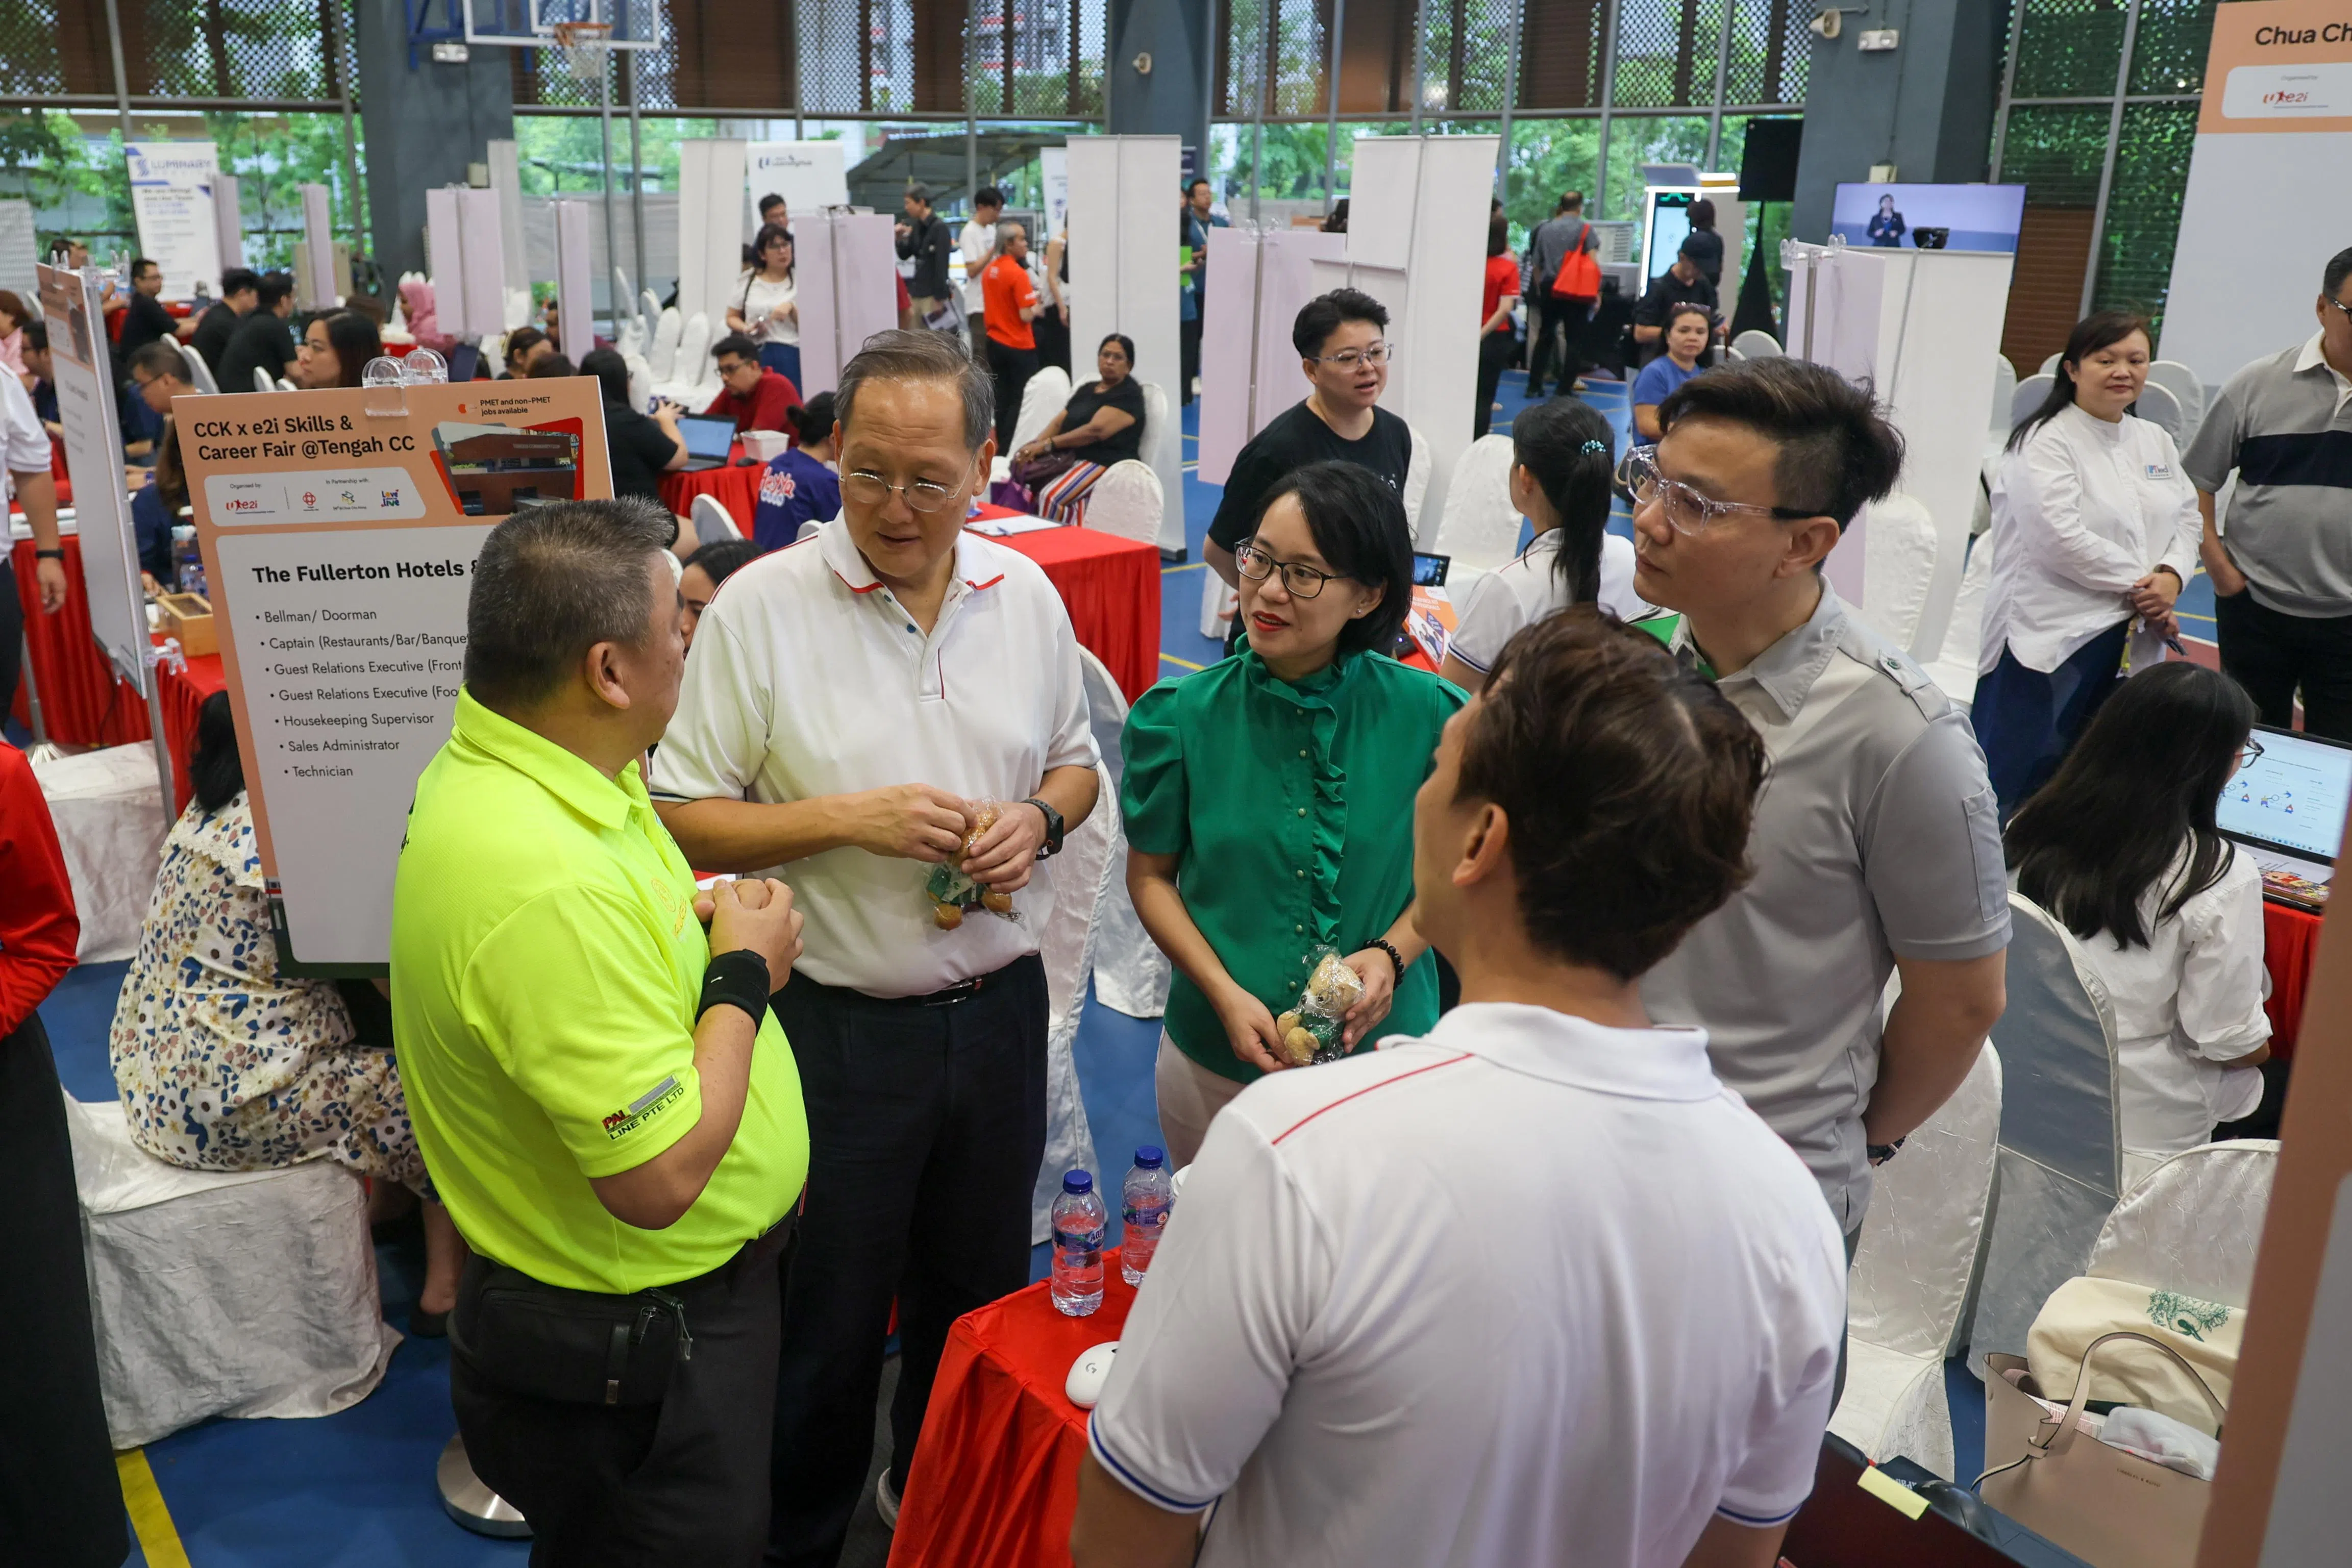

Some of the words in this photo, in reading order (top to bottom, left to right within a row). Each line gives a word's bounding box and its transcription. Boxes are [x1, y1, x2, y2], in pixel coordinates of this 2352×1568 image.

[2255, 26, 2317, 45] Chua
[194, 421, 232, 437] CCK
[236, 424, 248, 436] x
[253, 418, 279, 434] e2i
[284, 415, 335, 433] Skills
[340, 415, 353, 431] &
[199, 445, 257, 460] Career
[263, 441, 296, 457] Fair
[302, 436, 383, 459] @Tengah
[389, 436, 415, 451] CC
[252, 566, 290, 583] The
[297, 564, 390, 582] Fullerton
[397, 560, 464, 578] Hotels
[264, 610, 317, 624] Bellman/
[323, 610, 377, 621] Doorman
[269, 638, 314, 651] Captain
[274, 663, 308, 675] Guest
[312, 661, 365, 674] Relations
[368, 660, 424, 673] Executive
[428, 659, 462, 674] (Front
[279, 689, 313, 701] Guest
[317, 687, 369, 700] Relations
[374, 686, 428, 699] Executive
[432, 685, 460, 699] (Foo
[283, 714, 367, 728] Housekeeping
[372, 713, 434, 727] Supervisor
[288, 741, 318, 752] Sales
[323, 740, 400, 751] Administrator
[292, 765, 353, 777] Technician
[602, 1110, 631, 1130] PAL
[609, 1119, 640, 1140] LINE
[642, 1102, 665, 1122] PTE
[666, 1087, 684, 1104] LTD
